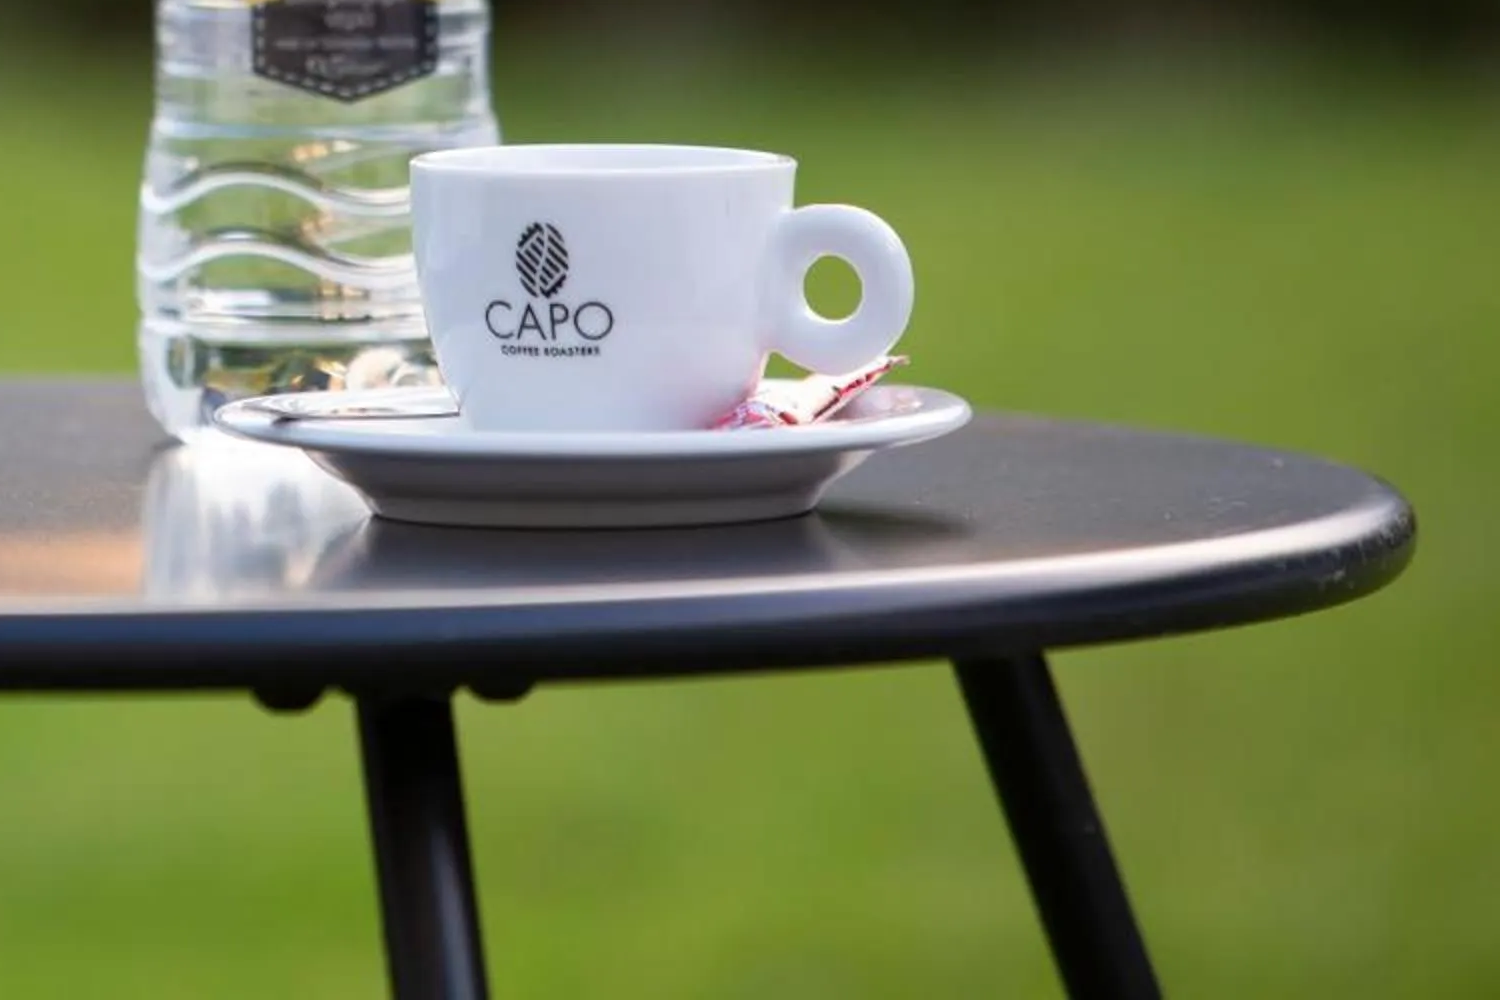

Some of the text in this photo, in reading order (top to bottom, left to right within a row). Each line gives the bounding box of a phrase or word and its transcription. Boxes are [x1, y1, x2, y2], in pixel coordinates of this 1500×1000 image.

[485, 300, 614, 341] CAPO
[501, 344, 600, 357] COFFEE ROASTERS
